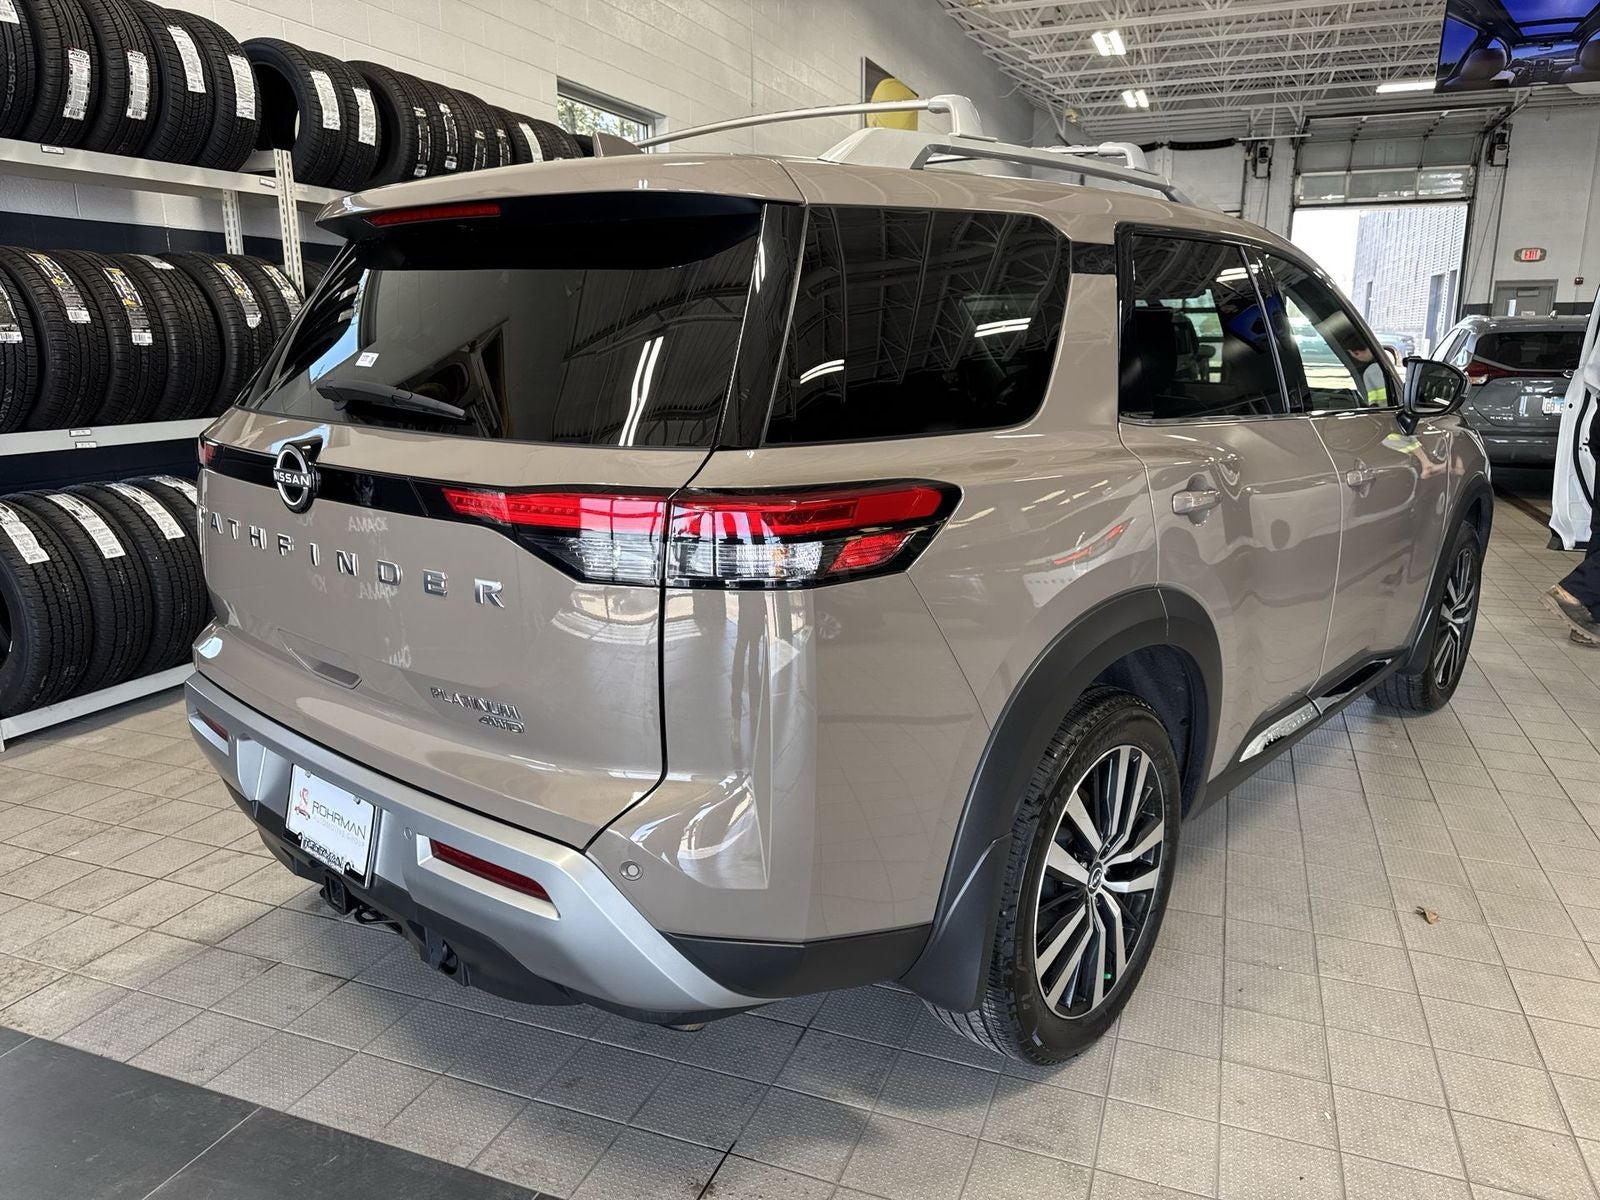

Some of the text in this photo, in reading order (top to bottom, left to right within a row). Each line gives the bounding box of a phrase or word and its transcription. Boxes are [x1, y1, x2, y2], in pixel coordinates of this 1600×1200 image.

[1524, 250, 1538, 259] EXIT
[274, 470, 310, 486] NISSAN
[430, 687, 521, 720] PLATINUM
[479, 715, 524, 733] 4WD
[312, 801, 367, 840] ROHRMAN
